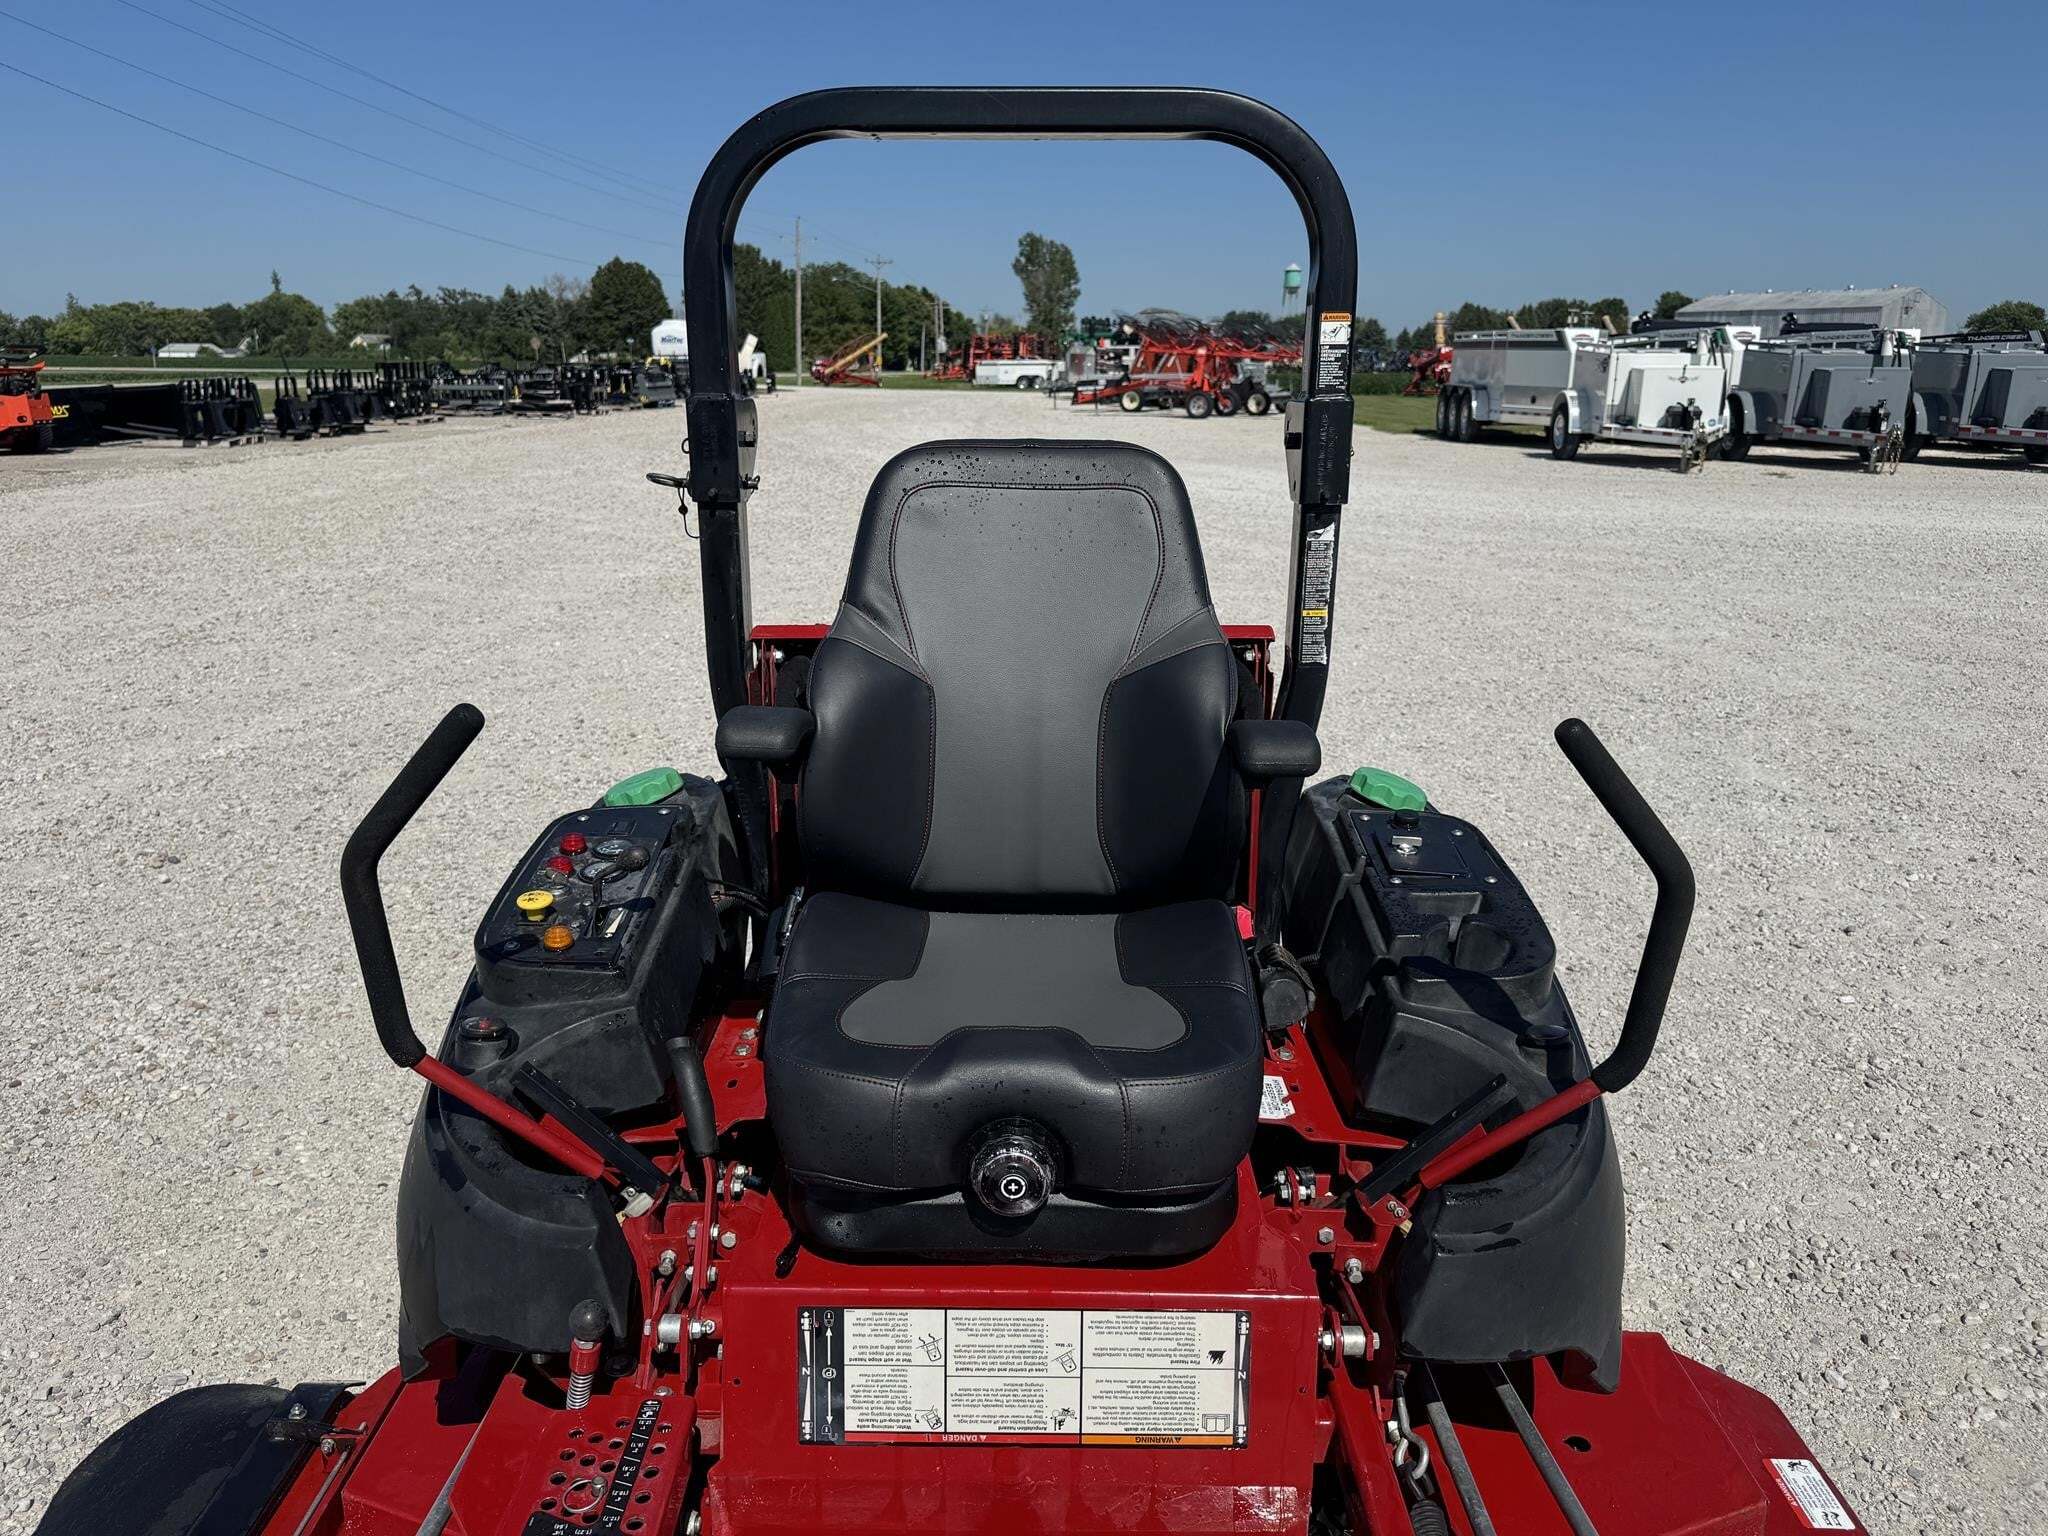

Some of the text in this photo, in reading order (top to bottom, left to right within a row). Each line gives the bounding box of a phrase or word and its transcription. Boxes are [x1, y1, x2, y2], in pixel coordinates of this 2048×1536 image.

[802, 1367, 811, 1375] N
[1238, 1371, 1247, 1379] N
[1775, 1478, 1794, 1502] DANGER
